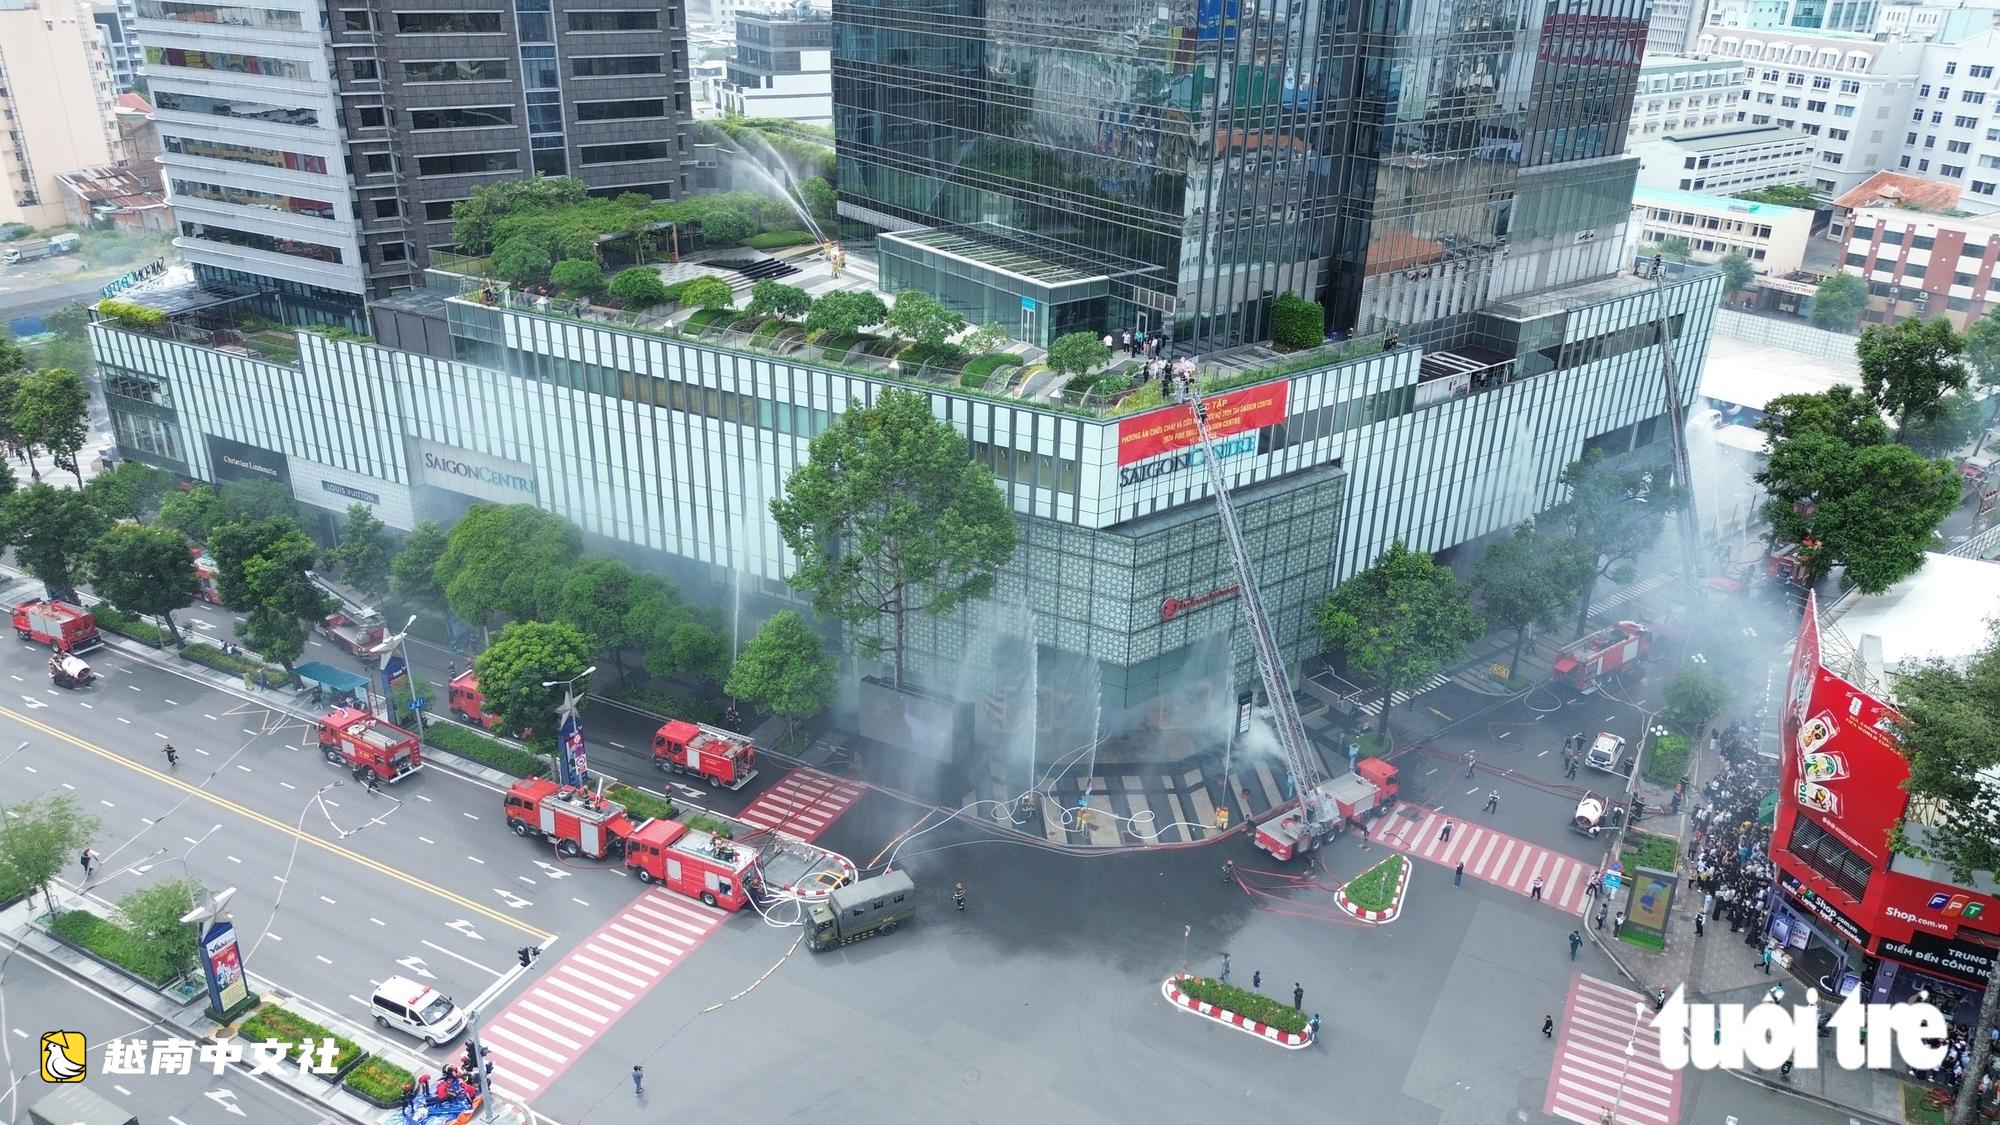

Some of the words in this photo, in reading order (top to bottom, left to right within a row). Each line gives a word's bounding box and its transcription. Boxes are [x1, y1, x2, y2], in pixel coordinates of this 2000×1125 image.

[1141, 429, 1150, 438] ÁN
[1240, 402, 1257, 413] SAIGON
[1257, 398, 1273, 409] CENTRE
[1188, 402, 1209, 415] TC
[1212, 399, 1228, 410] TẬP
[1174, 431, 1185, 440] FIRE
[1222, 416, 1241, 427] CENTRE
[1119, 436, 1256, 488] SAIGONCNTRE
[327, 483, 346, 495] LOUIS
[346, 487, 374, 501] VUITTON
[1857, 725, 1878, 740] WORLD
[1878, 738, 1890, 748] CUP
[1815, 896, 1858, 934] Shop.com.vn
[1930, 895, 1982, 916] FPT
[1885, 906, 1948, 931] Shop.com.vn
[1835, 922, 1862, 945] Accessories
[1885, 943, 1913, 957] ĐIỂM
[1915, 952, 1939, 964] ĐẾN
[1941, 959, 1975, 974] CÔNG
[1948, 948, 1988, 965] TRUNG
